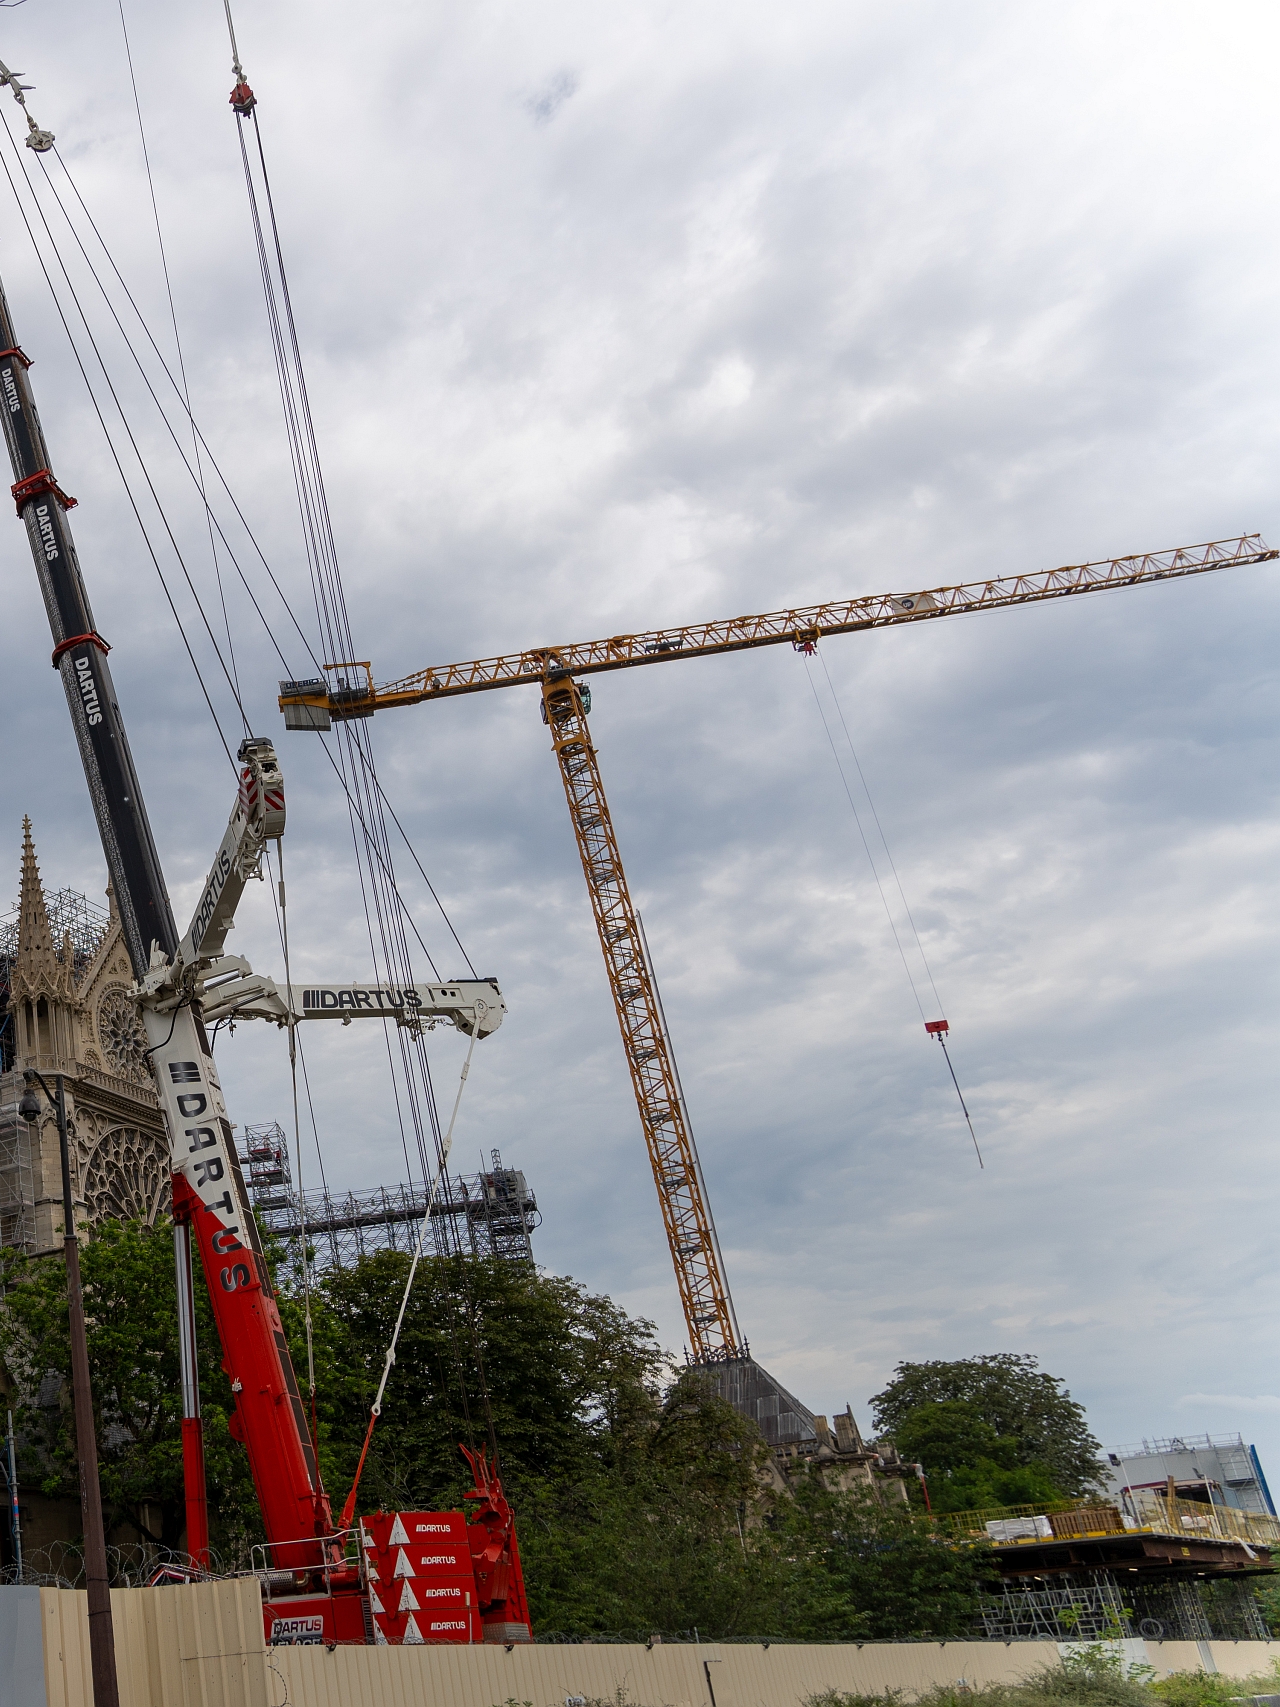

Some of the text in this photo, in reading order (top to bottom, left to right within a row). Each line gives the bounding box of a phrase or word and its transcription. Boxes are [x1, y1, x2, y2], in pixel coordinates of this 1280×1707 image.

[1, 368, 20, 413] DARTUS
[36, 504, 59, 561] DARTUS
[74, 656, 103, 726] DARTUS
[194, 848, 231, 938] DARTUS
[320, 988, 423, 1009] DARTUS
[177, 1093, 251, 1293] DARTUS
[421, 1524, 451, 1532] DARTUS
[427, 1556, 456, 1564] DARTUS
[432, 1588, 460, 1597] DARTUS
[274, 1619, 322, 1634] DARTUS
[436, 1620, 466, 1630] DARTUS
